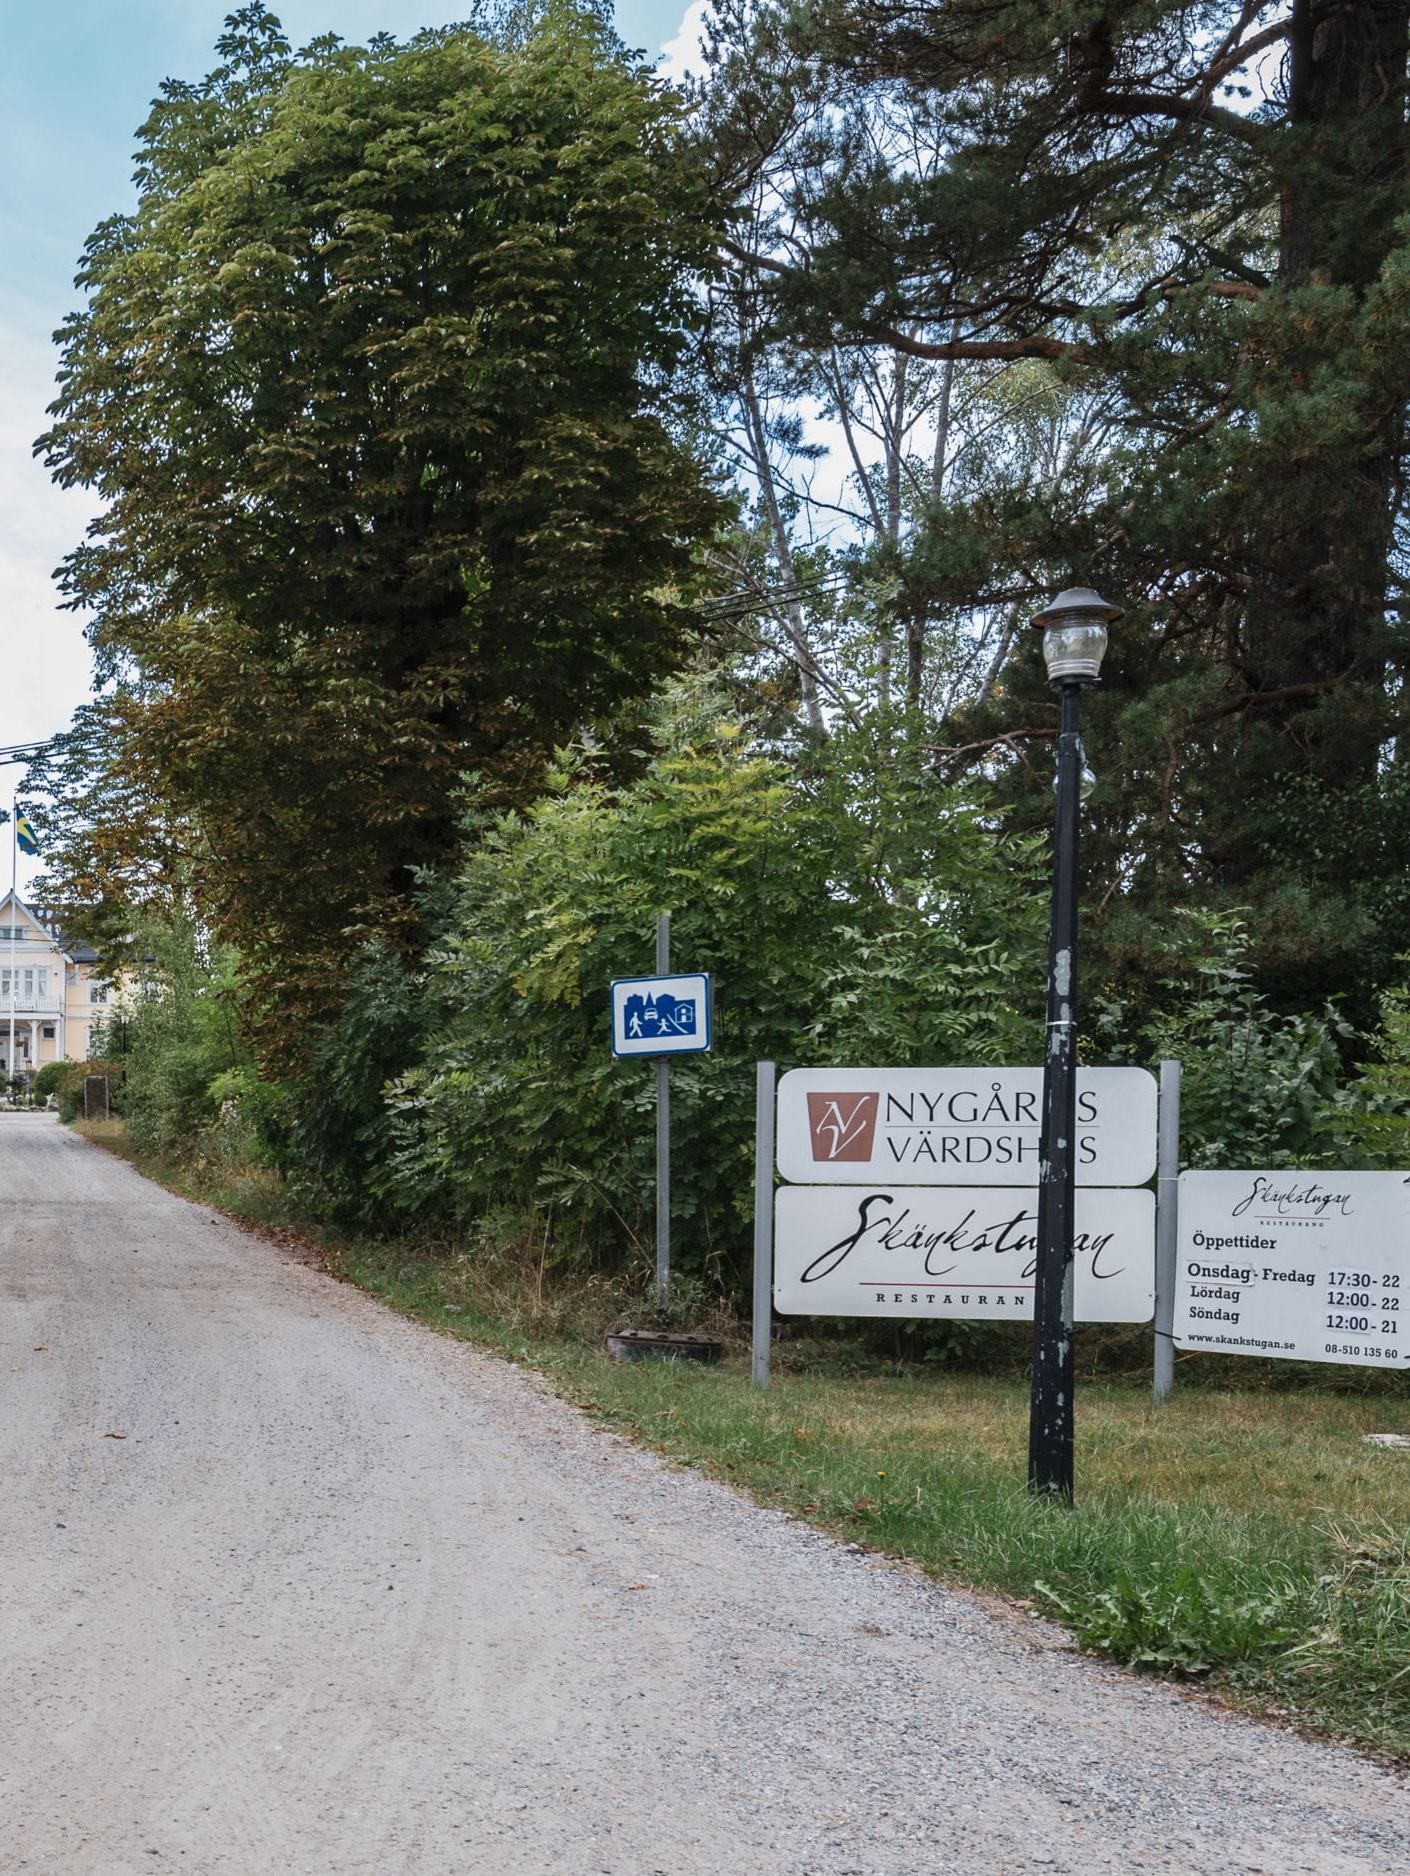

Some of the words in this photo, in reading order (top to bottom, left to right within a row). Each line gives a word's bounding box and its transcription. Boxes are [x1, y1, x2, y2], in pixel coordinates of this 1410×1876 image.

[886, 1083, 1098, 1122] NYGÅRS
[886, 1131, 1097, 1163] VÄRDSHS
[1232, 1177, 1355, 1216] Skänkstugan
[1193, 1230, 1277, 1250] Öppettider
[1188, 1263, 1251, 1281] Onsdag
[1262, 1268, 1315, 1286] Fredag
[1382, 1275, 1400, 1288] 22
[1190, 1286, 1240, 1302] Lördag
[1381, 1298, 1399, 1310] 22
[1189, 1306, 1240, 1324] Söndag
[1381, 1320, 1397, 1334] 21
[1188, 1333, 1295, 1350] www.skankstugan.se
[1325, 1344, 1359, 1356] 08-510
[1363, 1347, 1381, 1358] 135
[1385, 1349, 1398, 1359] 60
